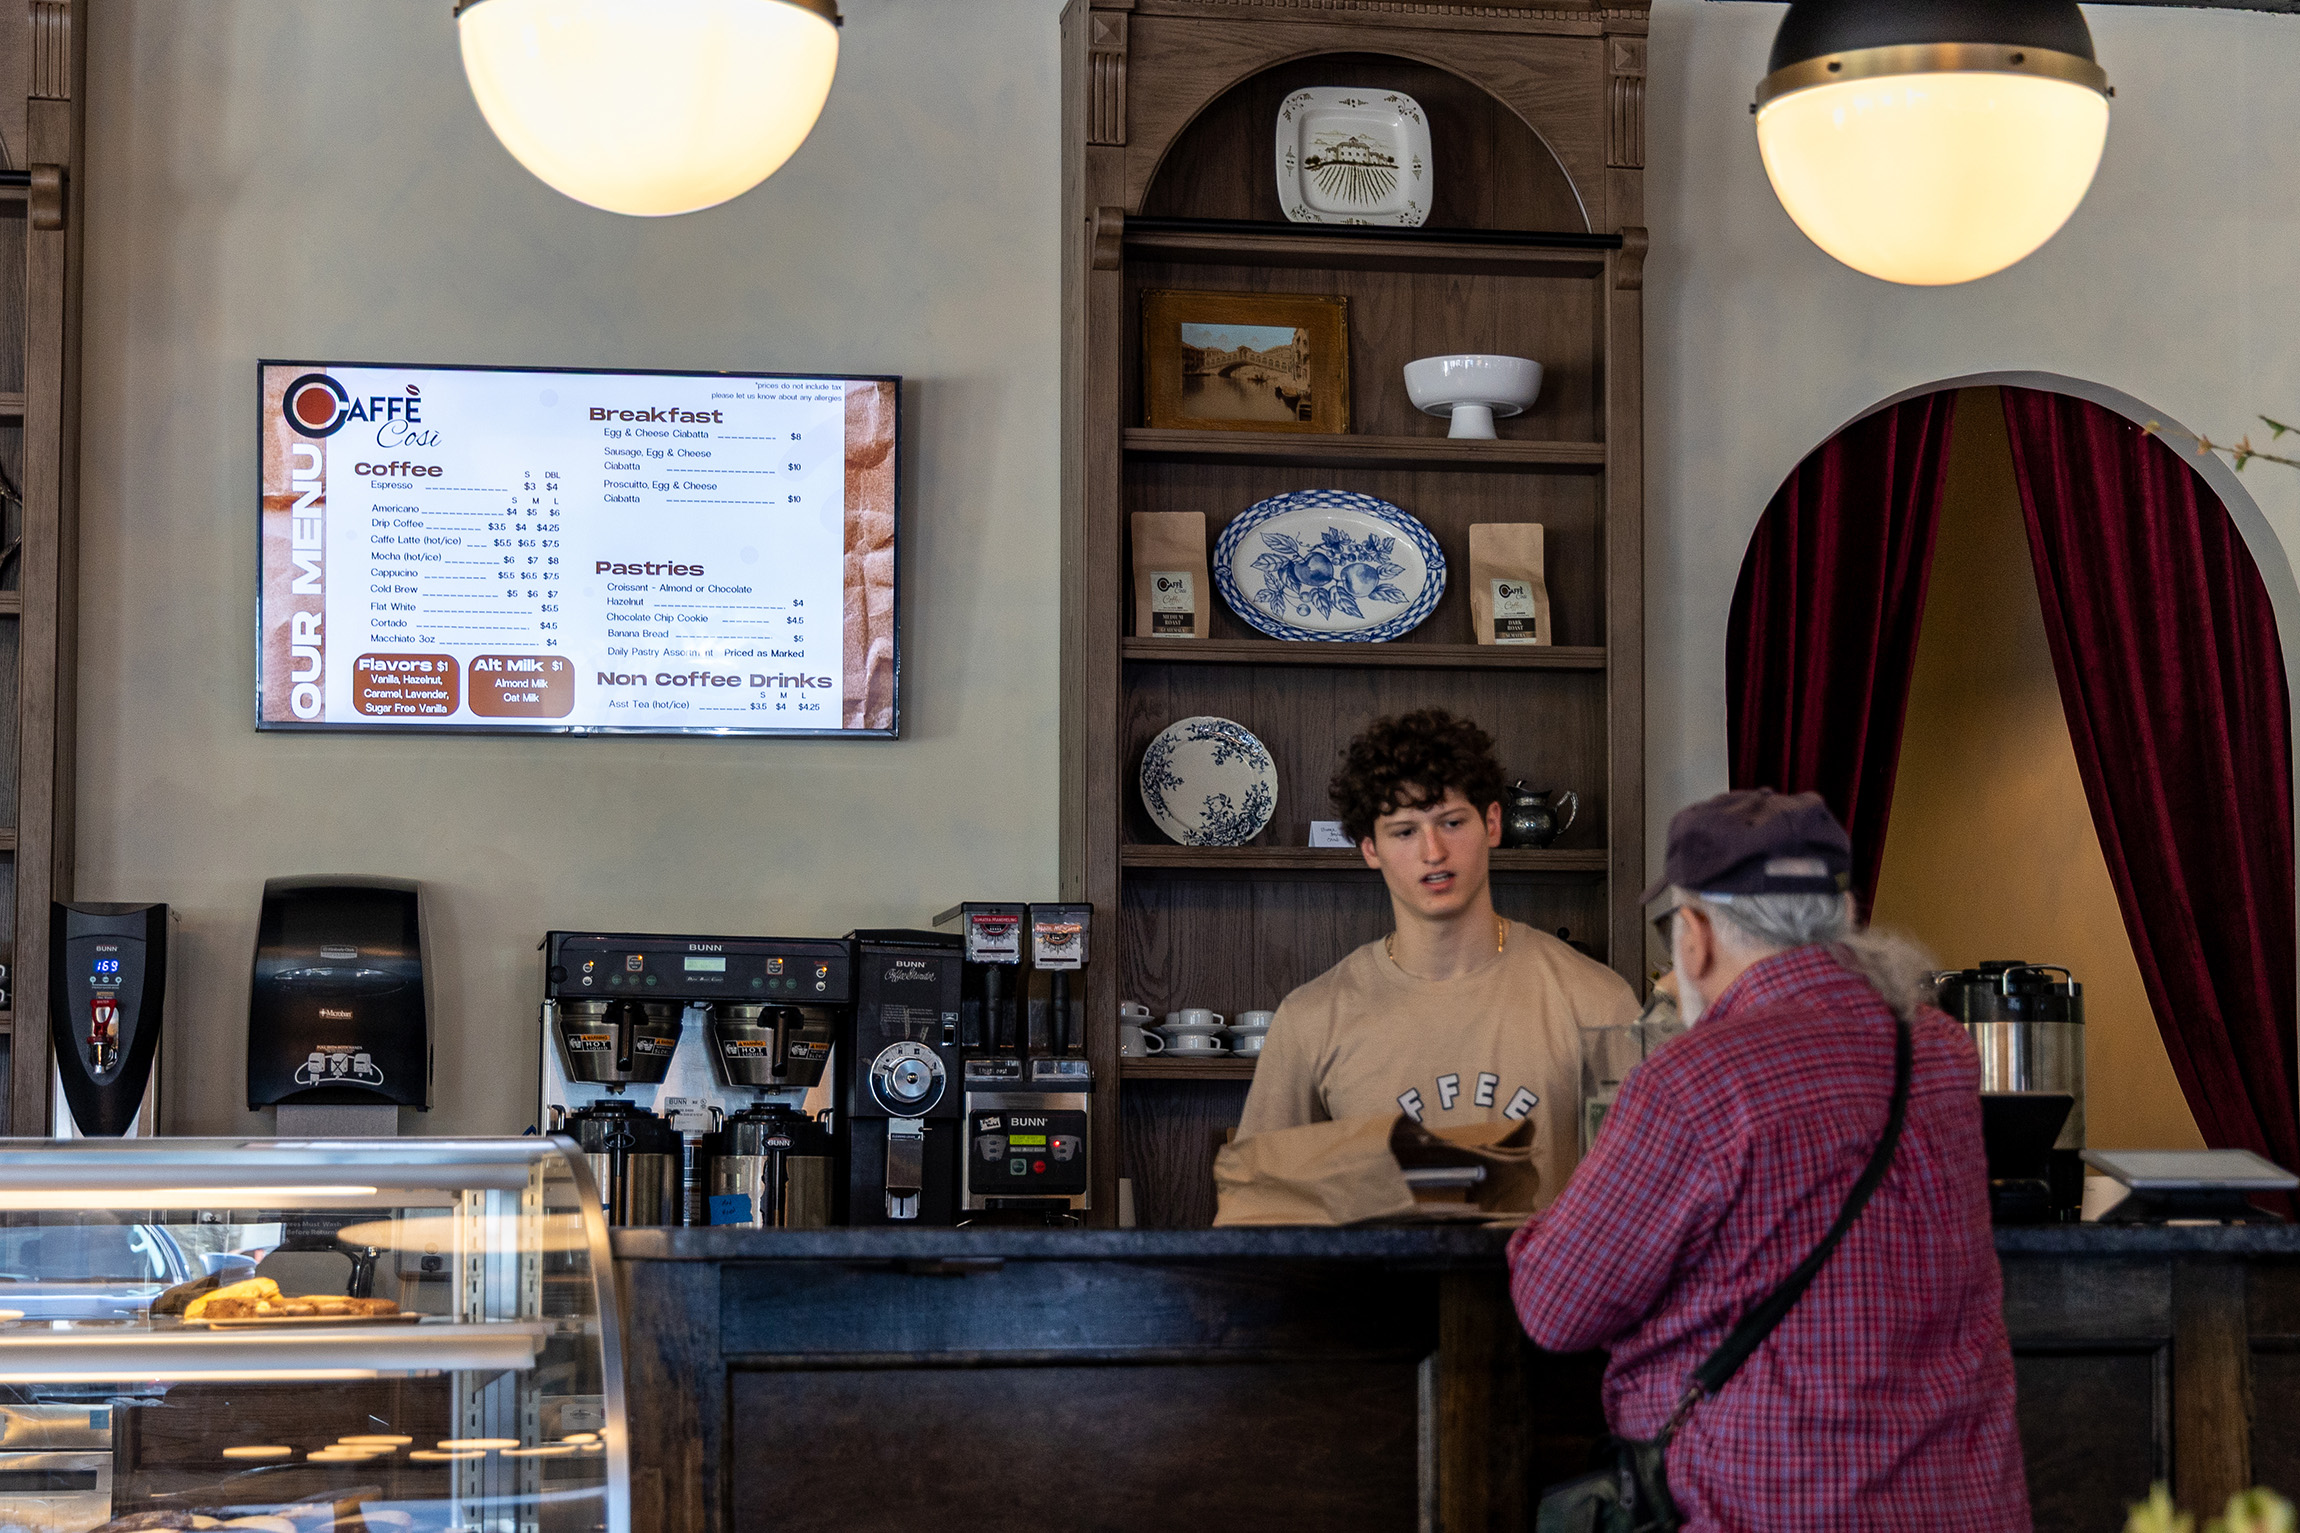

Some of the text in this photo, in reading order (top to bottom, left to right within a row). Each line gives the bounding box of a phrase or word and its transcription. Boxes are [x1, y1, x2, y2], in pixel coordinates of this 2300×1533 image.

[814, 395, 842, 403] allergies
[590, 407, 723, 423] Breakfast
[604, 428, 621, 439] Egg
[625, 428, 631, 436] &
[635, 429, 669, 437] Cheese
[673, 430, 708, 438] Ciabatta
[605, 447, 643, 458] Sausage,
[647, 448, 663, 459] Egg
[677, 449, 711, 457] Cheese
[355, 461, 443, 477] Coffee
[604, 462, 801, 471] Ciabatta $10
[371, 480, 557, 491] Espresso $3 $4
[604, 480, 717, 491] Proscuitto, Egg & Cheese
[604, 494, 801, 503] Ciabatta $10
[372, 504, 419, 513] Americano
[372, 519, 390, 528] Drip
[393, 519, 423, 527] Coffee
[516, 523, 526, 531] $4
[371, 535, 394, 543] Caffe
[398, 536, 420, 544] Latte
[424, 536, 461, 545] (hot/ice)
[372, 552, 559, 565] Mocha (hot/ice) $6 $7 $8
[371, 568, 418, 578] Cappucino
[596, 561, 704, 576] Pastries
[291, 443, 324, 720] OUR MENU
[395, 585, 418, 593] Brew
[528, 590, 538, 598] $6
[548, 590, 558, 598] $7
[607, 583, 648, 591] Croissant
[660, 584, 692, 592] Almond
[708, 585, 752, 593] Chocolate
[371, 602, 386, 610] Flat
[391, 603, 416, 611] White
[607, 597, 803, 607] Hazelnut $4
[371, 619, 407, 627] Cortado
[607, 613, 651, 621] Chocolate
[654, 614, 674, 623] Chip
[677, 614, 708, 622] Cookie
[608, 629, 639, 637] Banana
[371, 634, 415, 642] Macchiato
[419, 635, 435, 643] 3oz
[608, 647, 628, 657] Daily
[632, 648, 659, 658] Pastry
[359, 658, 448, 672] Flavors $1
[474, 658, 563, 672] Alt Milk $1
[371, 674, 443, 685] Vanilla, Hazelnut,
[495, 679, 548, 689] Almond Milk
[598, 671, 832, 688] Non Coffee Drinks
[364, 689, 449, 700] Caramel, Lavender,
[503, 693, 540, 703] Oat Milk
[365, 704, 448, 714] Sugar Free Vanilla
[609, 700, 628, 708] Asst
[633, 700, 649, 708] Tea
[653, 701, 689, 709] (hot/ice)
[689, 944, 722, 952] BUNN
[97, 960, 118, 972] 169
[1011, 1118, 1045, 1126] BUNN
